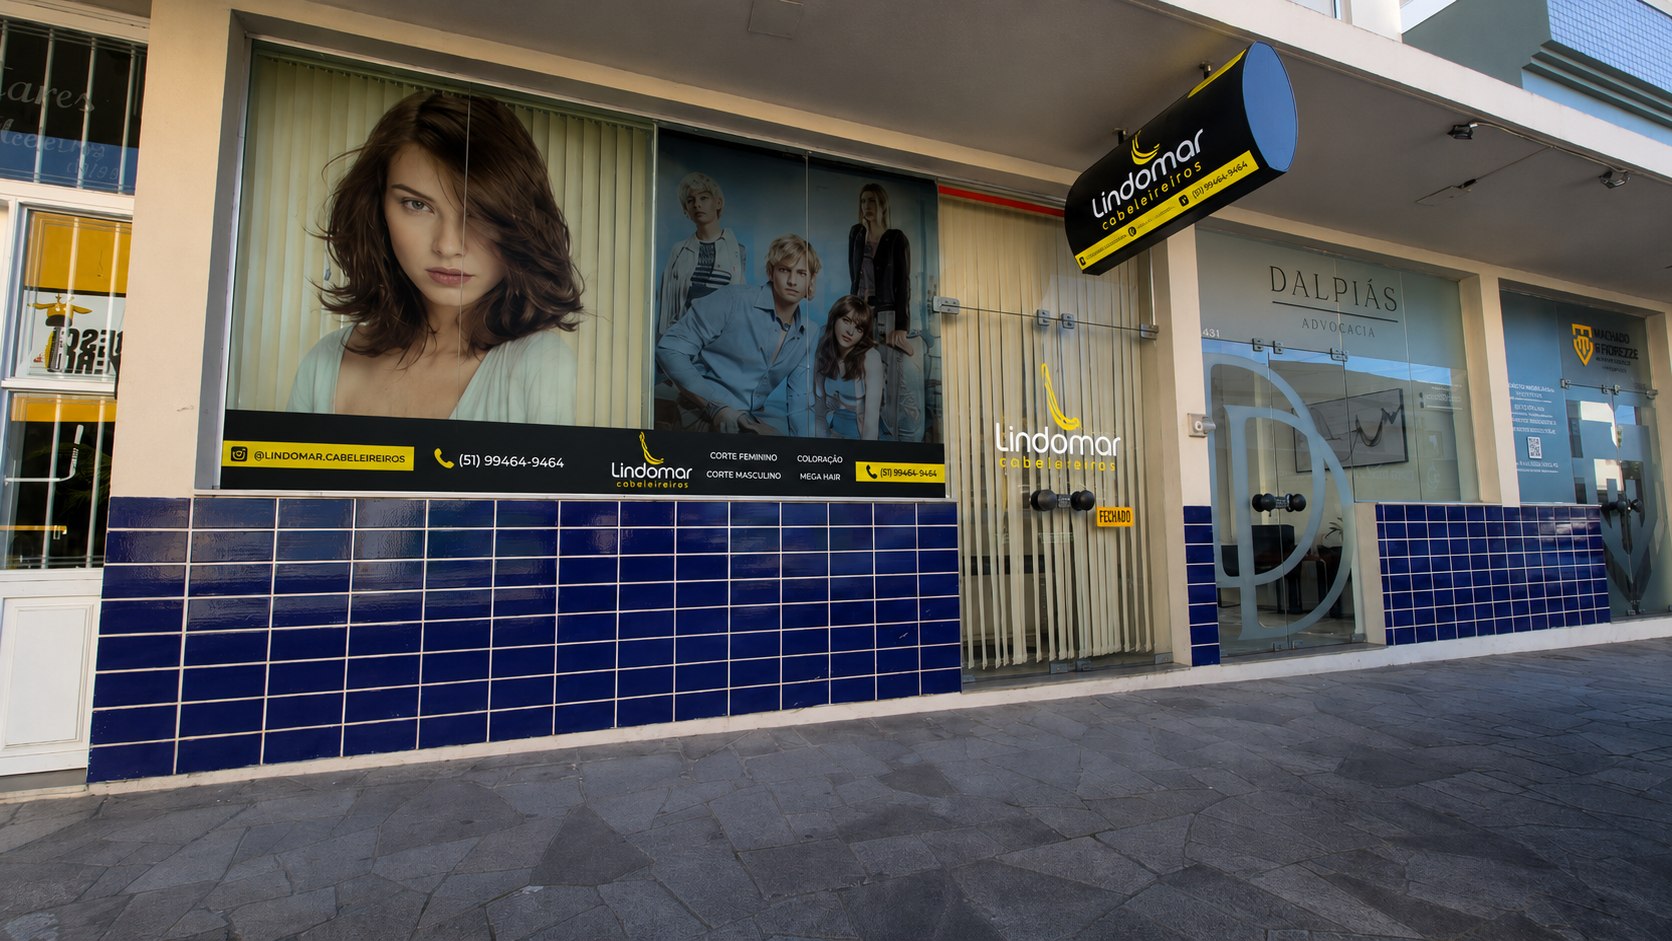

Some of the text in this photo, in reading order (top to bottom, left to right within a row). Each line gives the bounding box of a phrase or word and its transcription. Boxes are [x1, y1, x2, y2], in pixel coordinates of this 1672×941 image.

[1092, 129, 1204, 219] Lindomar
[1102, 161, 1202, 231] cabeleireiros
[1269, 265, 1398, 313] DALPIÁS
[1202, 327, 1220, 339] 431
[1301, 317, 1376, 339] ADVOCACIA
[995, 422, 1121, 457] Lindomar
[254, 450, 406, 464] @LINDOMAR.CABELEIREIROS
[458, 453, 565, 469] (51) 99464-9464
[709, 451, 778, 462] CORTE FEMININO
[999, 456, 1116, 472] cabelereiros
[611, 462, 693, 480] Lindomar
[706, 470, 781, 480] CORTE MASCULINO
[800, 472, 841, 481] MEGA HAIR
[1099, 509, 1131, 523] FECHADO
